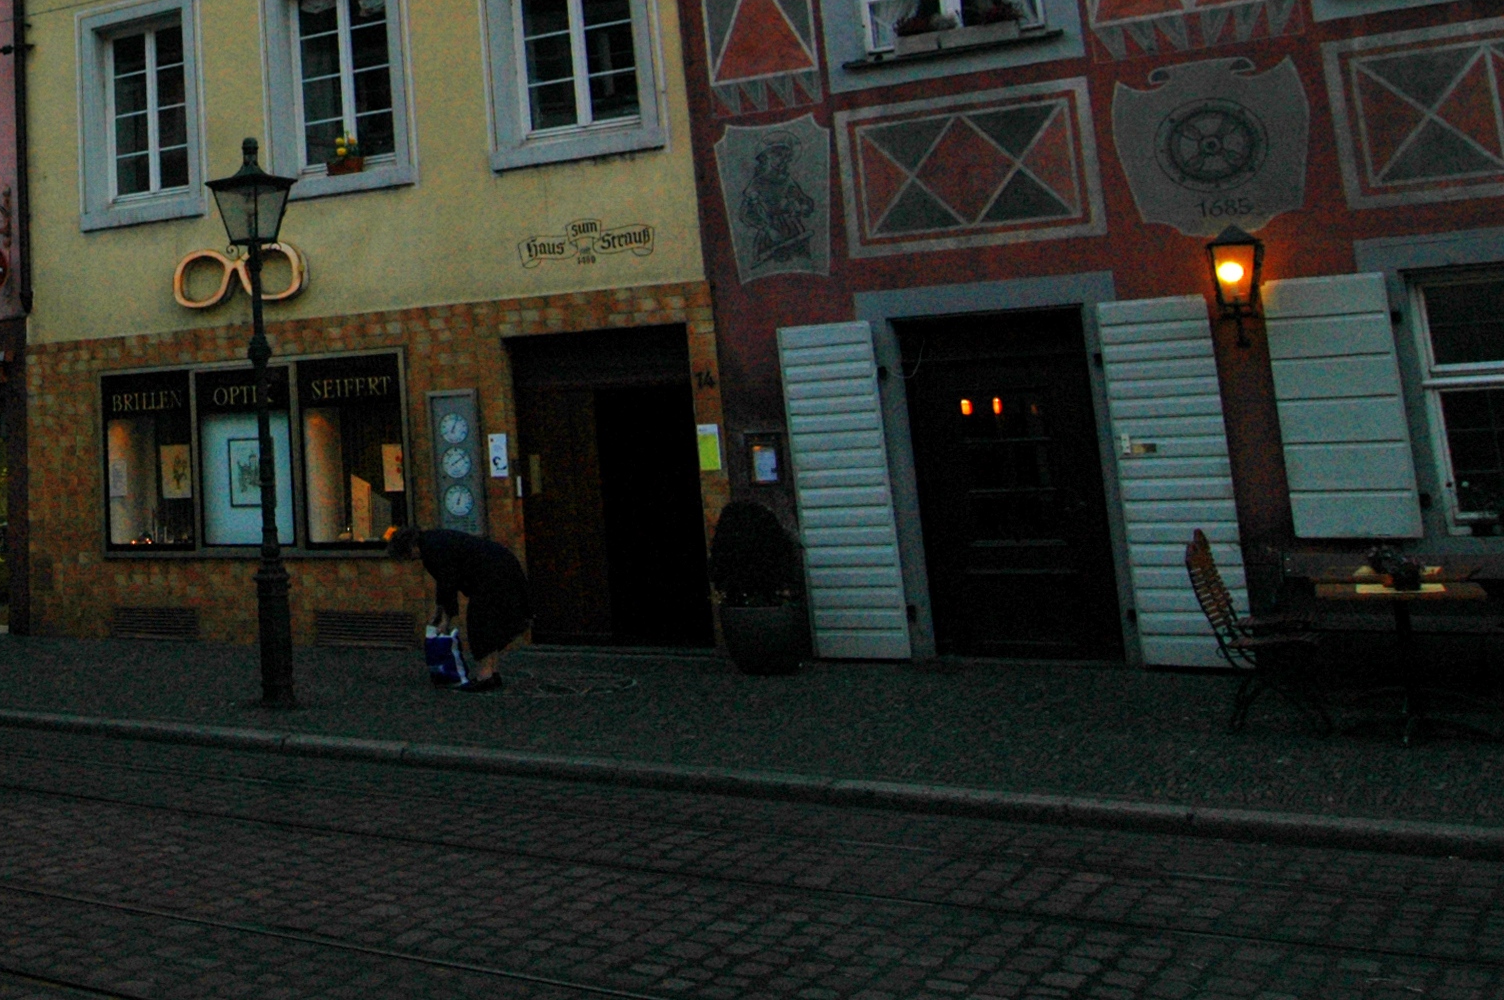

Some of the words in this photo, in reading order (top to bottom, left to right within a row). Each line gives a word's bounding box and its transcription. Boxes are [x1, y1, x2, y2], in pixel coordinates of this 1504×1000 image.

[1195, 198, 1253, 218] 1685
[527, 237, 566, 258] Haus
[310, 375, 392, 400] SEIFERT
[695, 370, 716, 389] 14
[111, 389, 183, 412] BRILLEN
